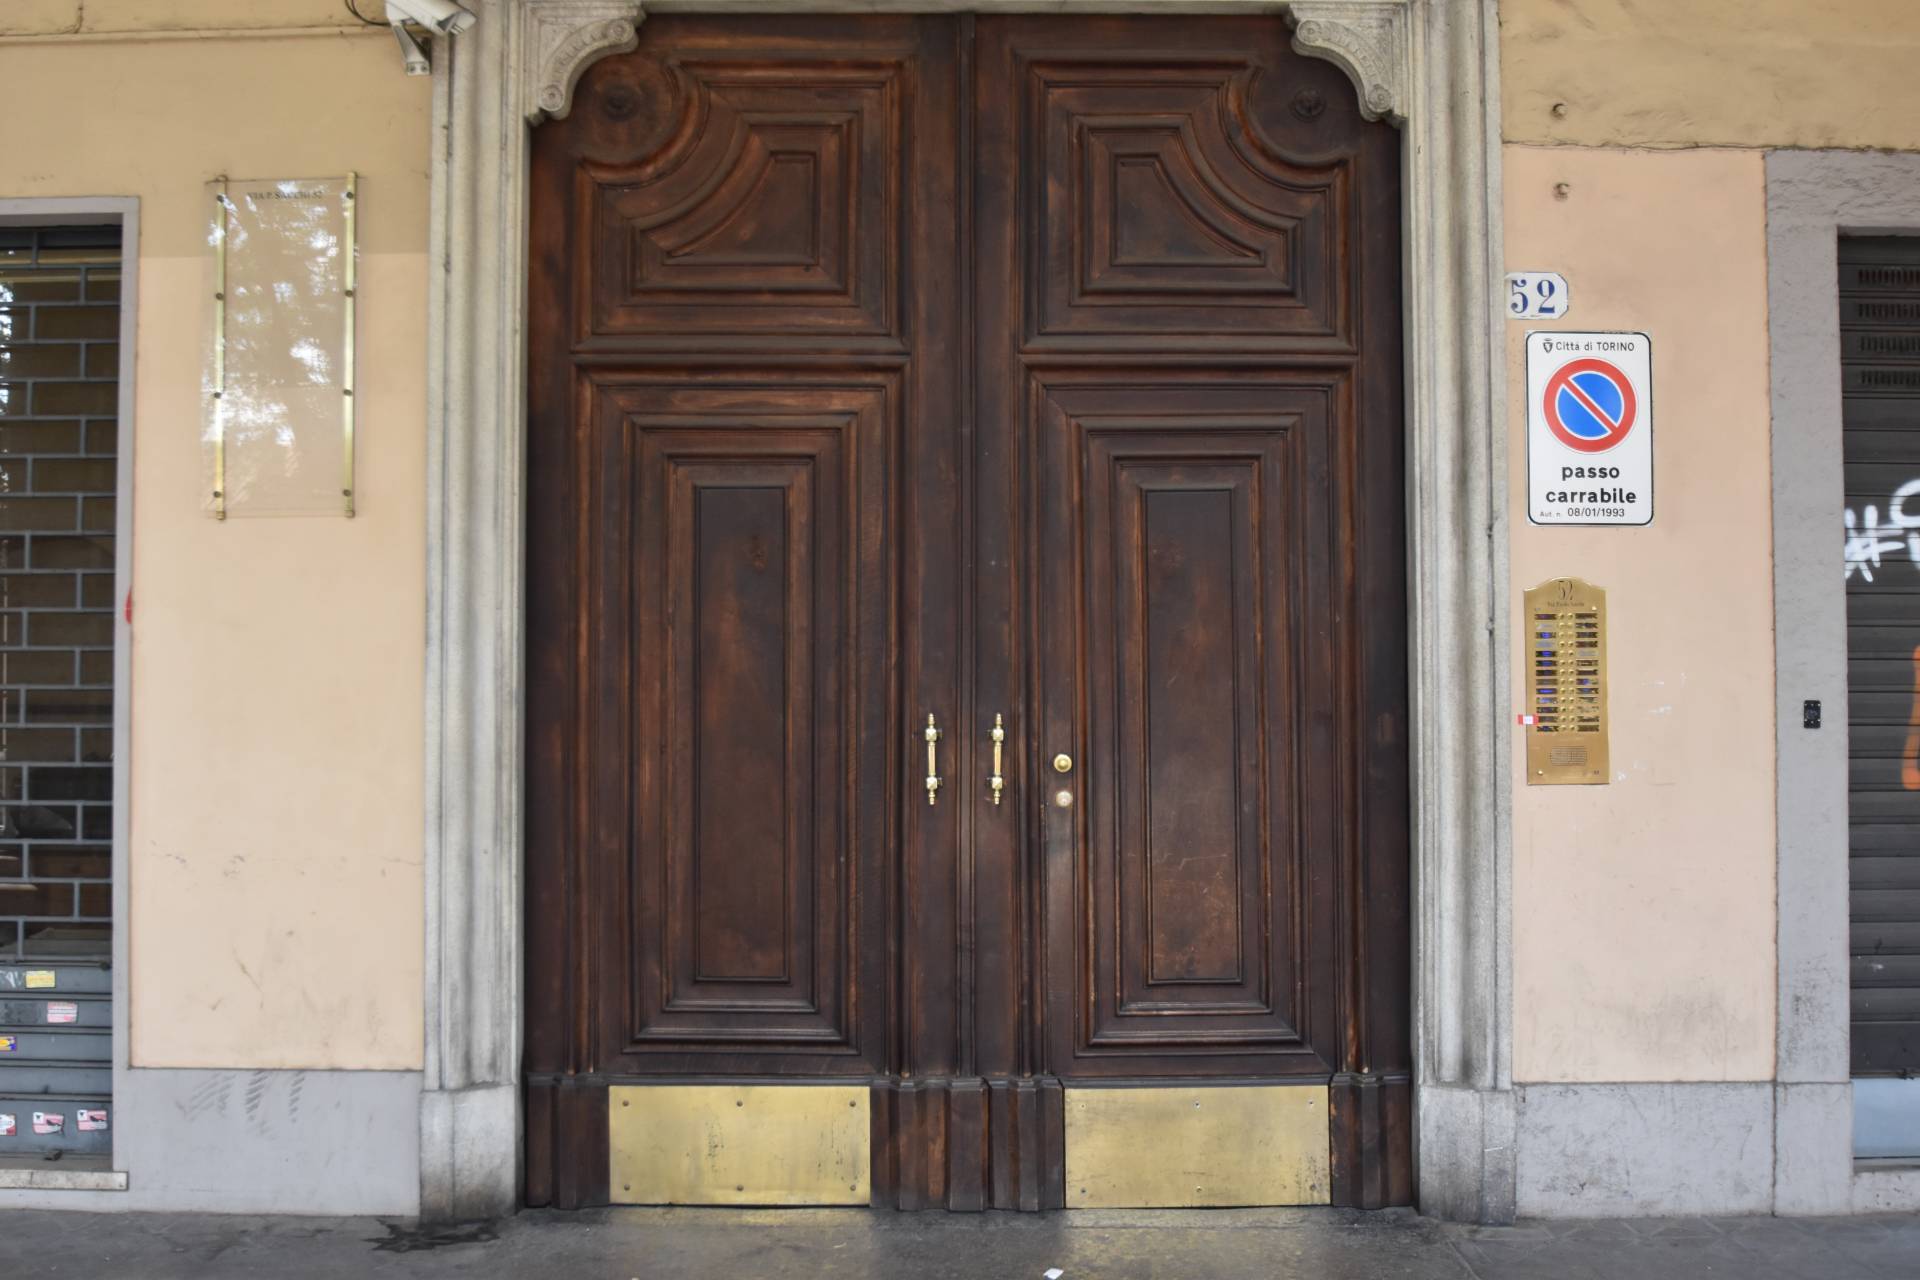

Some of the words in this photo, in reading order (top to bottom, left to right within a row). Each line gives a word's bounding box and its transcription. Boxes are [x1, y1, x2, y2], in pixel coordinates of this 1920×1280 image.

[1511, 279, 1555, 314] 52
[1584, 341, 1593, 351] di
[1597, 342, 1635, 351] TORINO
[1561, 466, 1620, 481] passo
[1546, 488, 1637, 503] carrabile
[1567, 507, 1625, 517] 08/01/1993
